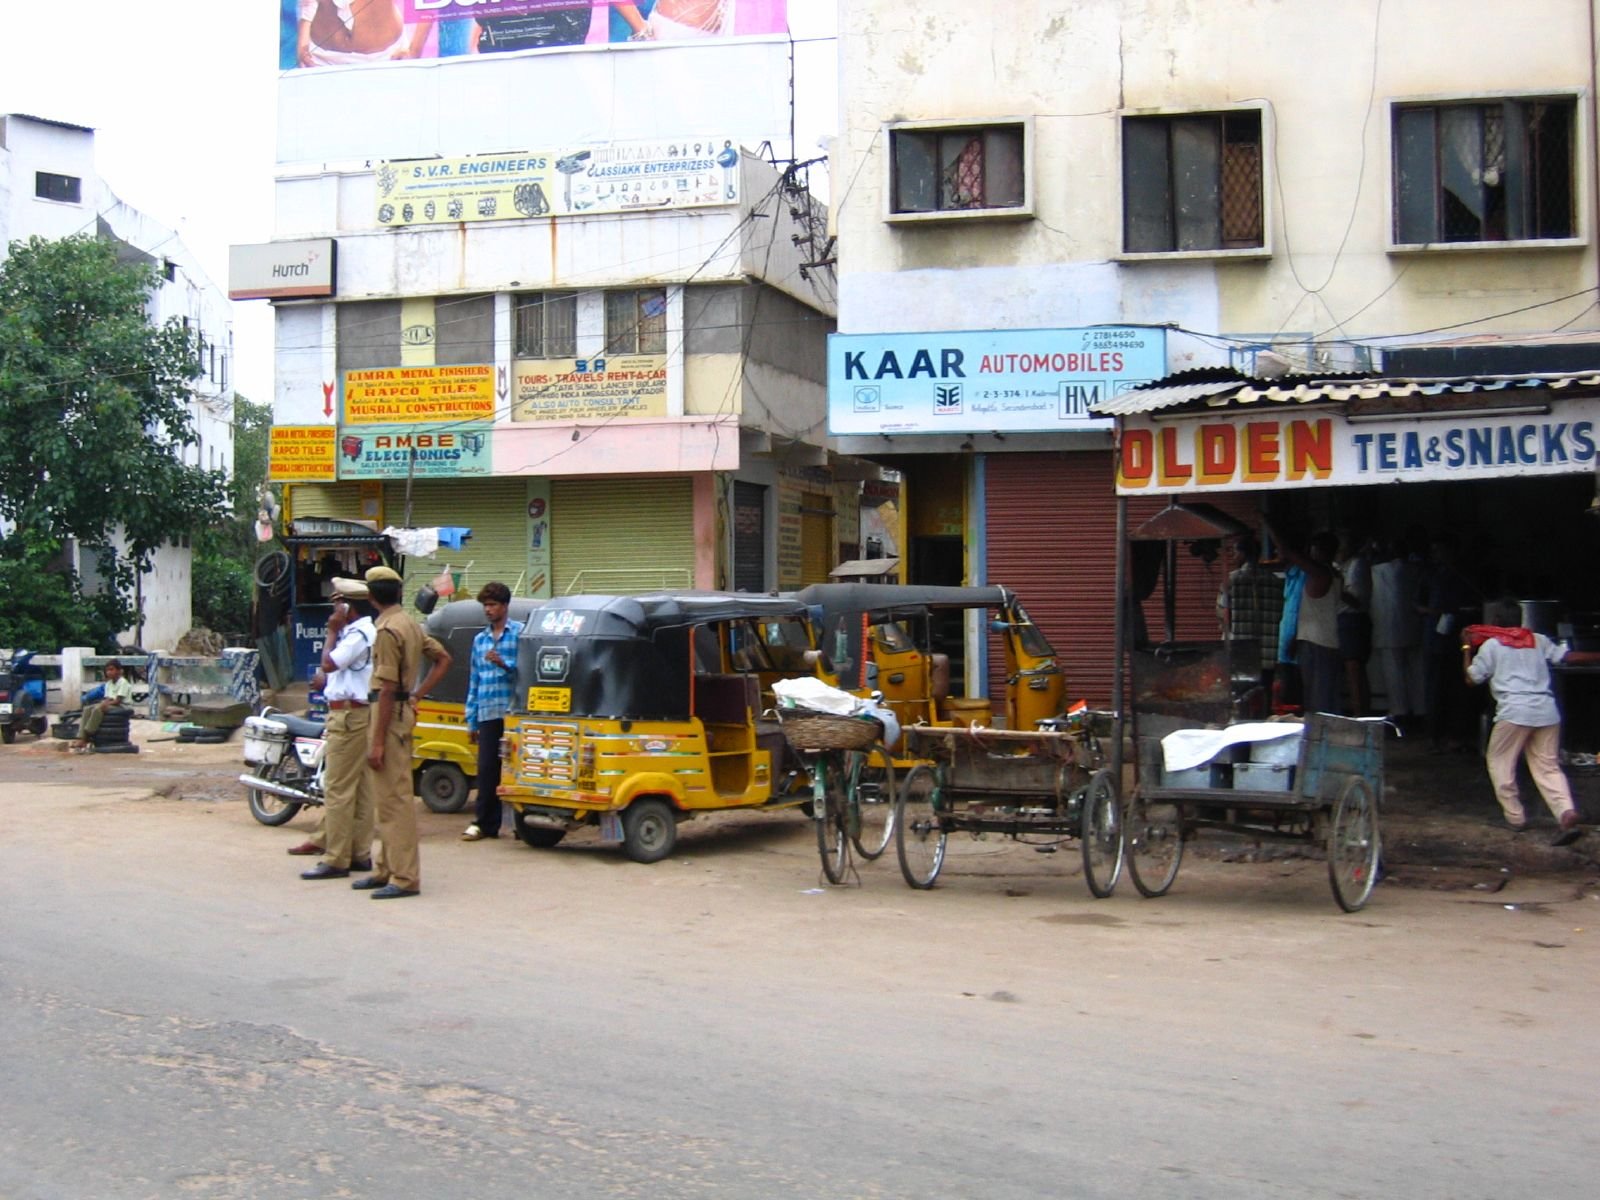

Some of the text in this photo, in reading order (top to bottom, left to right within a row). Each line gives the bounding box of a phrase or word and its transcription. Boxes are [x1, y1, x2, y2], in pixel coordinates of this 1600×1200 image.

[413, 165, 453, 178] S.V.R.
[459, 158, 547, 174] ENGINEERS
[587, 159, 715, 178] CLASSIAKK ENTERPRIZESS
[845, 348, 967, 380] KAAR
[979, 352, 1124, 374] AUTOMOBILES
[348, 366, 489, 381] LIMRA METAL FINISHERS
[518, 369, 667, 385] TOURS TRAVELS RENT-A-CAR
[431, 384, 477, 395] TILES
[351, 400, 492, 415] MUSRAJ CONSTRUCTIONS
[531, 397, 640, 409] ALSO AUTO CONSULTANT
[1065, 385, 1103, 414] HM
[375, 434, 454, 448] AMBE
[302, 445, 326, 455] TILES
[1117, 418, 1333, 488] OLDEN
